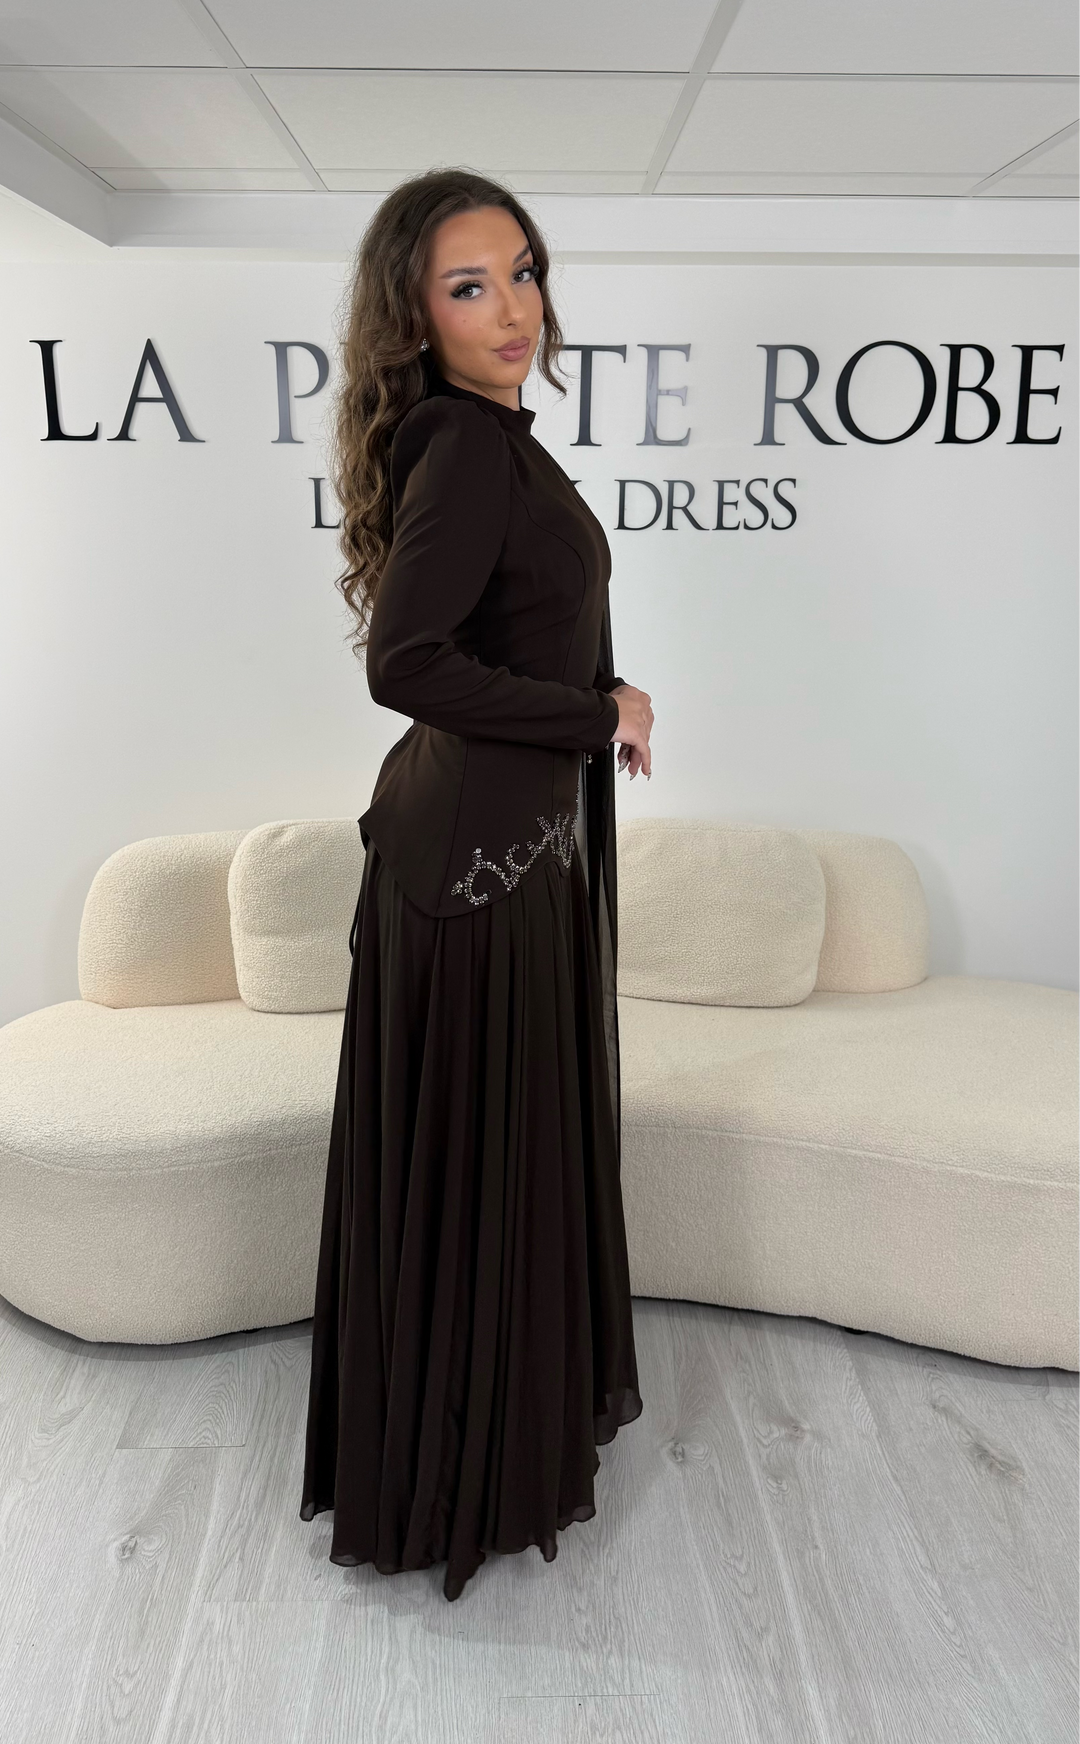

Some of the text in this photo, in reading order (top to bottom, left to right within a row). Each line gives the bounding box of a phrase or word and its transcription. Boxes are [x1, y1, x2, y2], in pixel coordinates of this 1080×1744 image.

[29, 338, 1066, 446] LA PTE ROBE
[613, 478, 798, 531] DRESS
